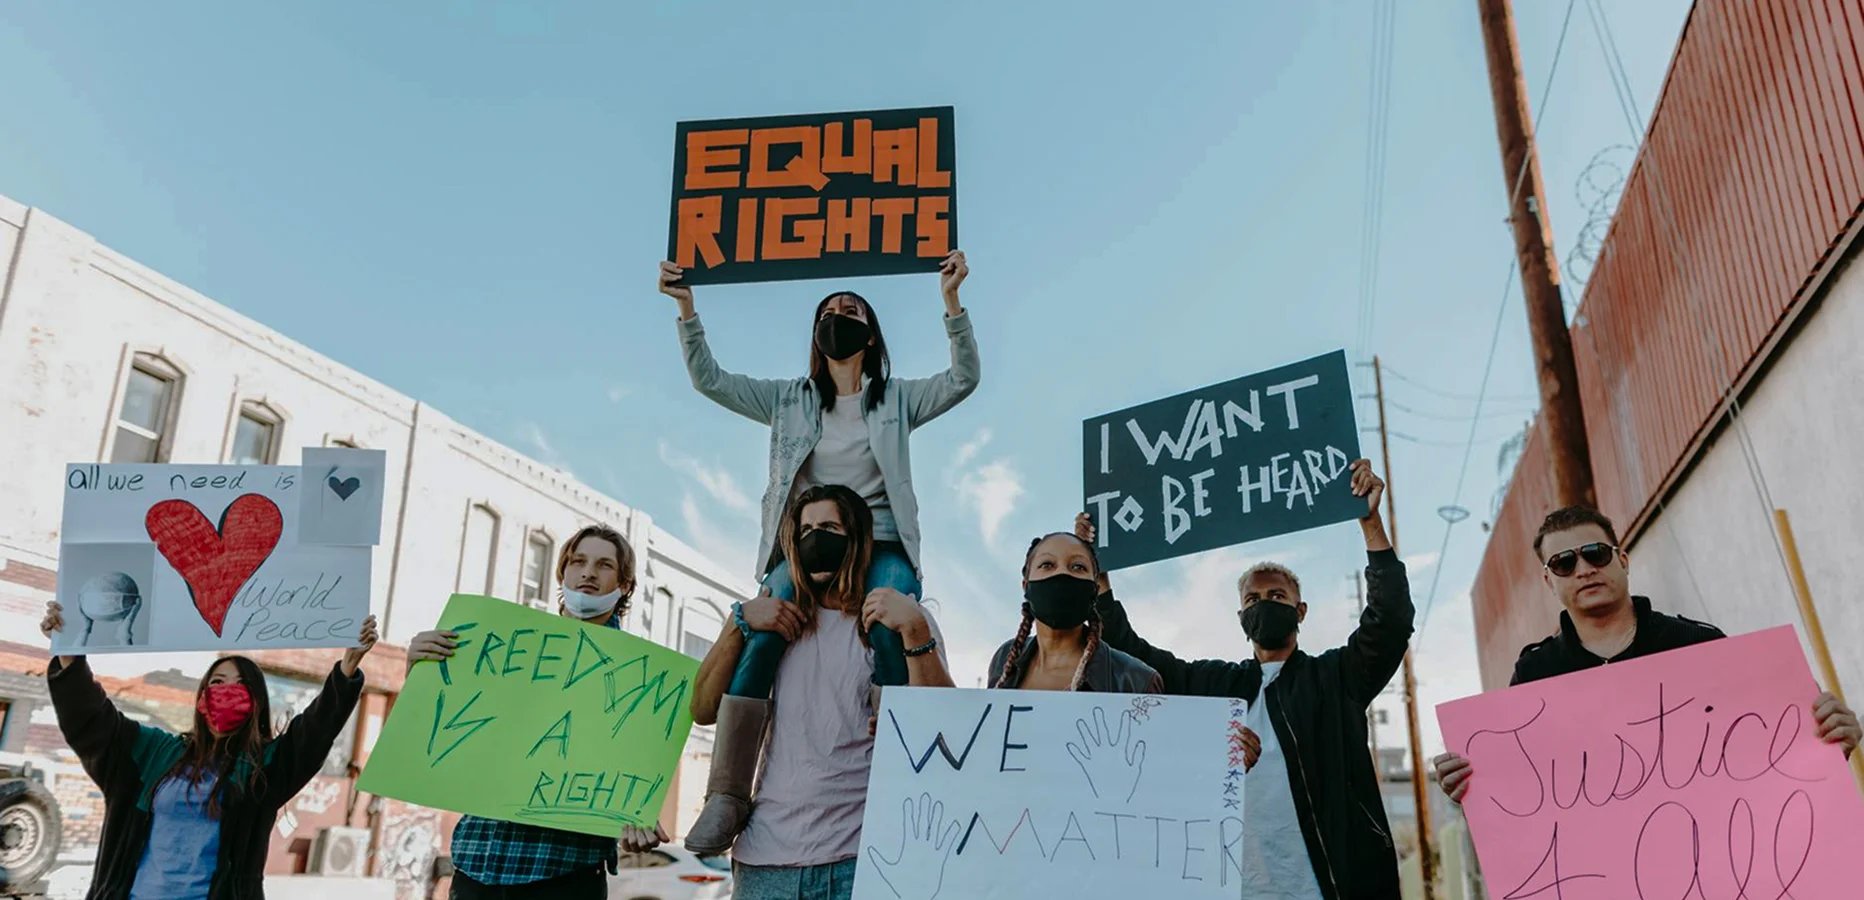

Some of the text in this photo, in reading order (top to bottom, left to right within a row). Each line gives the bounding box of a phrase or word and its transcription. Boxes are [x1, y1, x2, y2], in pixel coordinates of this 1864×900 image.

[685, 117, 951, 192] EQUAL
[676, 195, 950, 269] RIGHTS
[1100, 374, 1318, 474] I WANT
[108, 473, 144, 491] we
[170, 470, 248, 491] need
[274, 471, 294, 490] is
[1086, 445, 1348, 548] TO BE HEARD
[233, 572, 345, 610] World
[235, 608, 360, 643] Peace
[436, 622, 689, 740] FREEDOM
[426, 689, 572, 768] IS A
[887, 703, 1033, 773] WE
[1465, 682, 1827, 817] Justice
[528, 771, 664, 815] RIGHT!
[955, 807, 1244, 888] MATTER
[1503, 821, 1606, 900] 4
